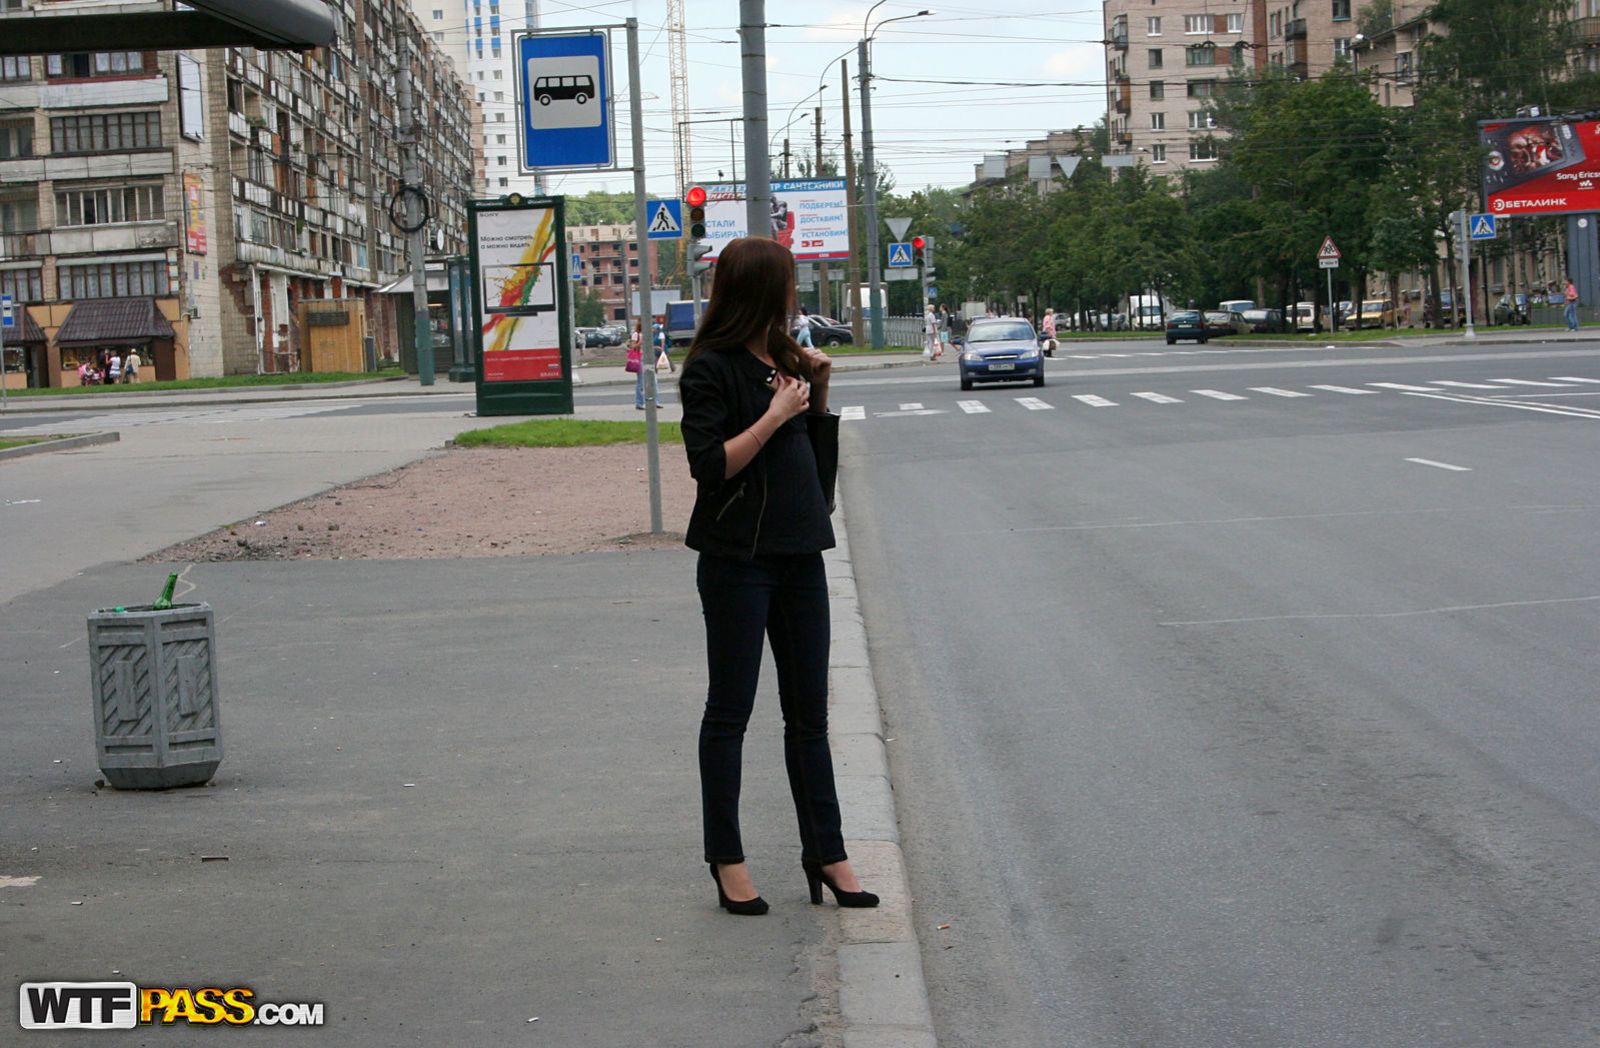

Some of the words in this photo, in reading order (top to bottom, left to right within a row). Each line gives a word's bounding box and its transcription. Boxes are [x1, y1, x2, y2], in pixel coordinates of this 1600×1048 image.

[1556, 172, 1578, 181] Sony
[1505, 198, 1567, 208] БЕТАЛИНК
[800, 214, 843, 224] ДОСТАВИМ!
[704, 220, 736, 228] СТАЛИ
